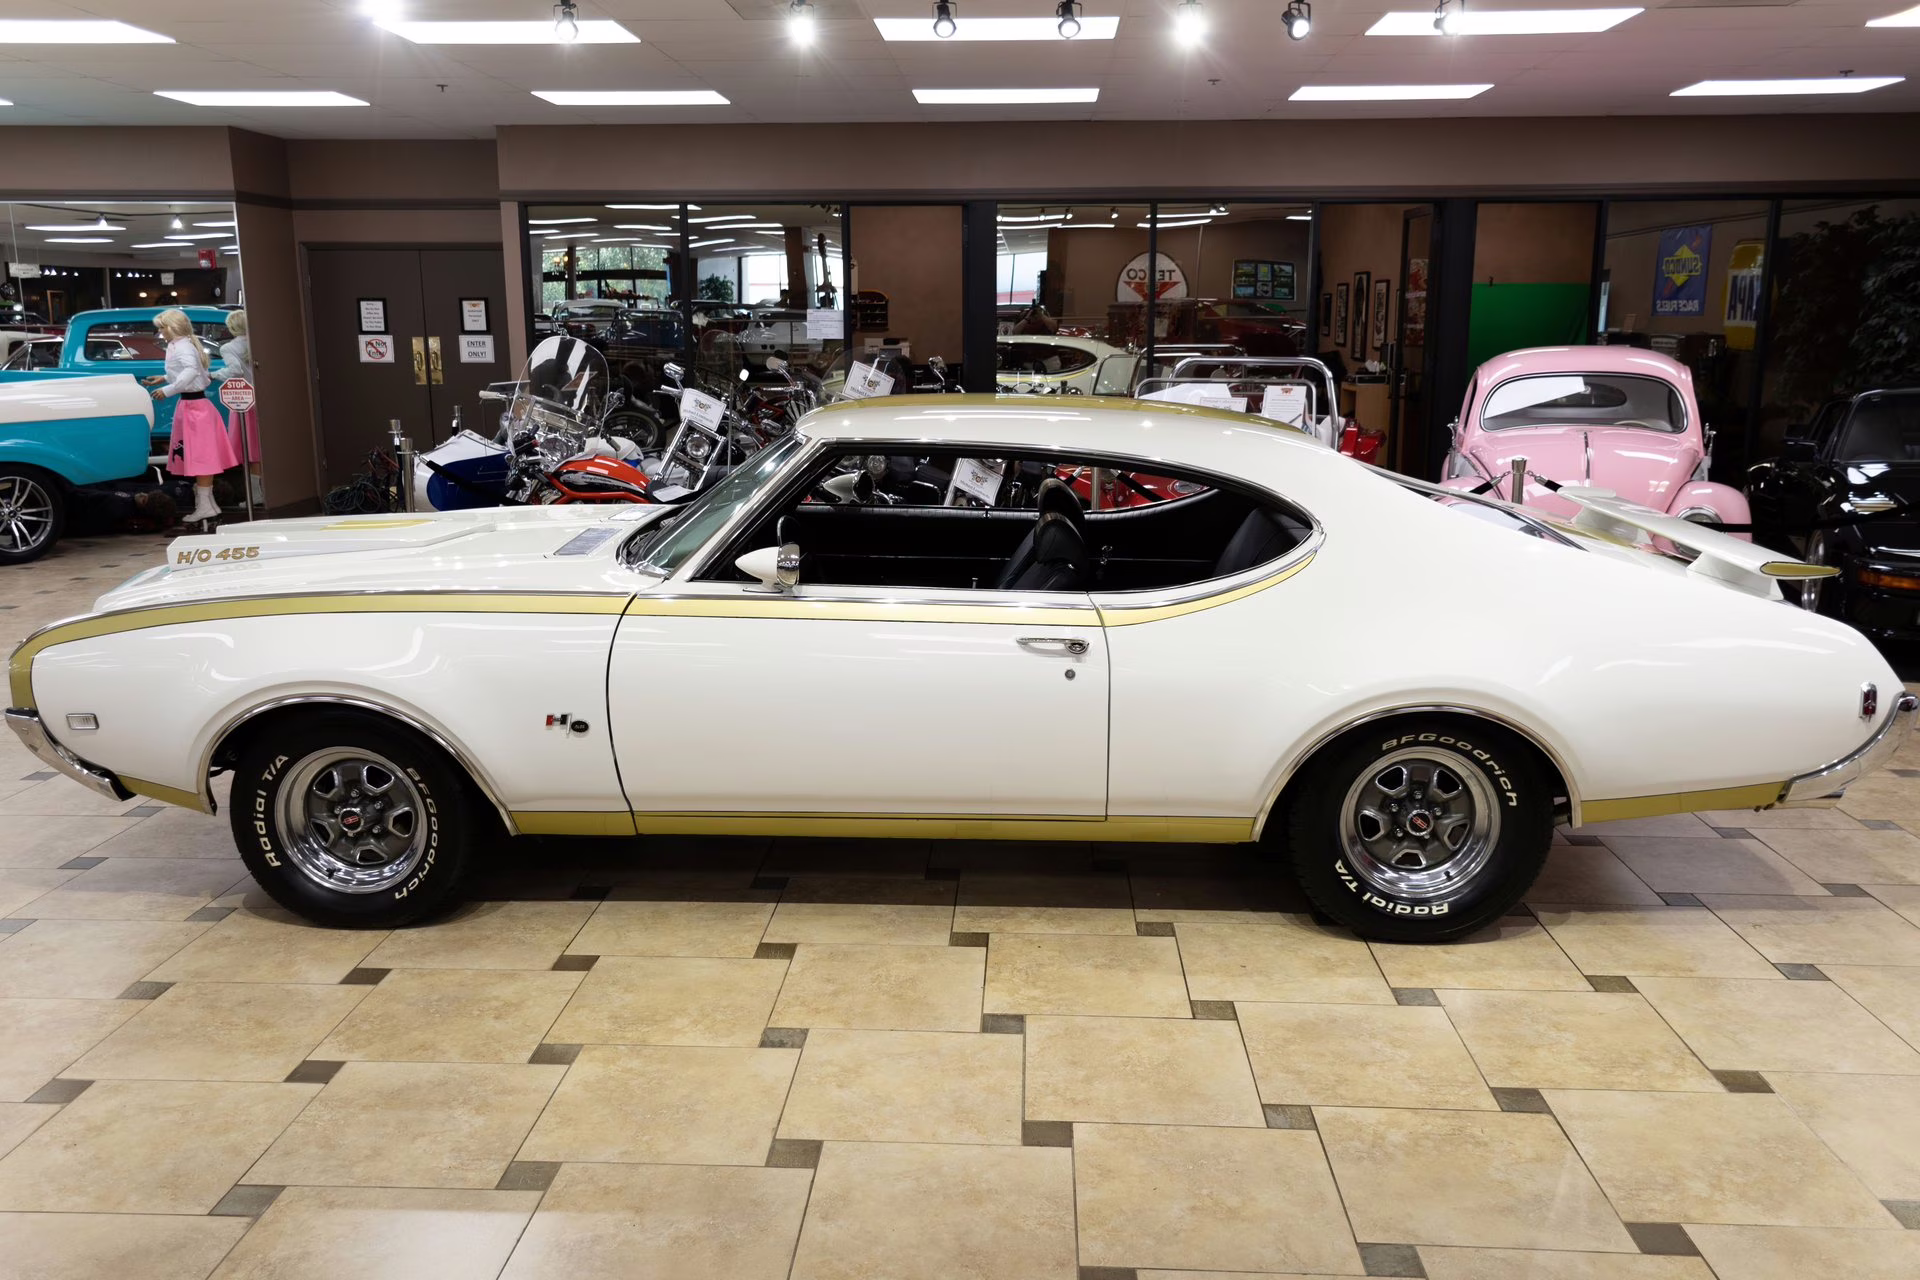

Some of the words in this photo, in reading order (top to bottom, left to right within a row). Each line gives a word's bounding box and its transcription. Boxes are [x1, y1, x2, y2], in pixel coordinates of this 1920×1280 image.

[227, 381, 246, 389] STOP
[177, 548, 212, 565] H/O
[215, 546, 260, 561] 455
[261, 754, 289, 782] T/A
[1381, 733, 1518, 807] BFGoodrich
[253, 789, 282, 867] Radial
[395, 767, 438, 900] BFGoodrich
[1334, 859, 1359, 893] T/A
[1362, 892, 1450, 916] Radial
